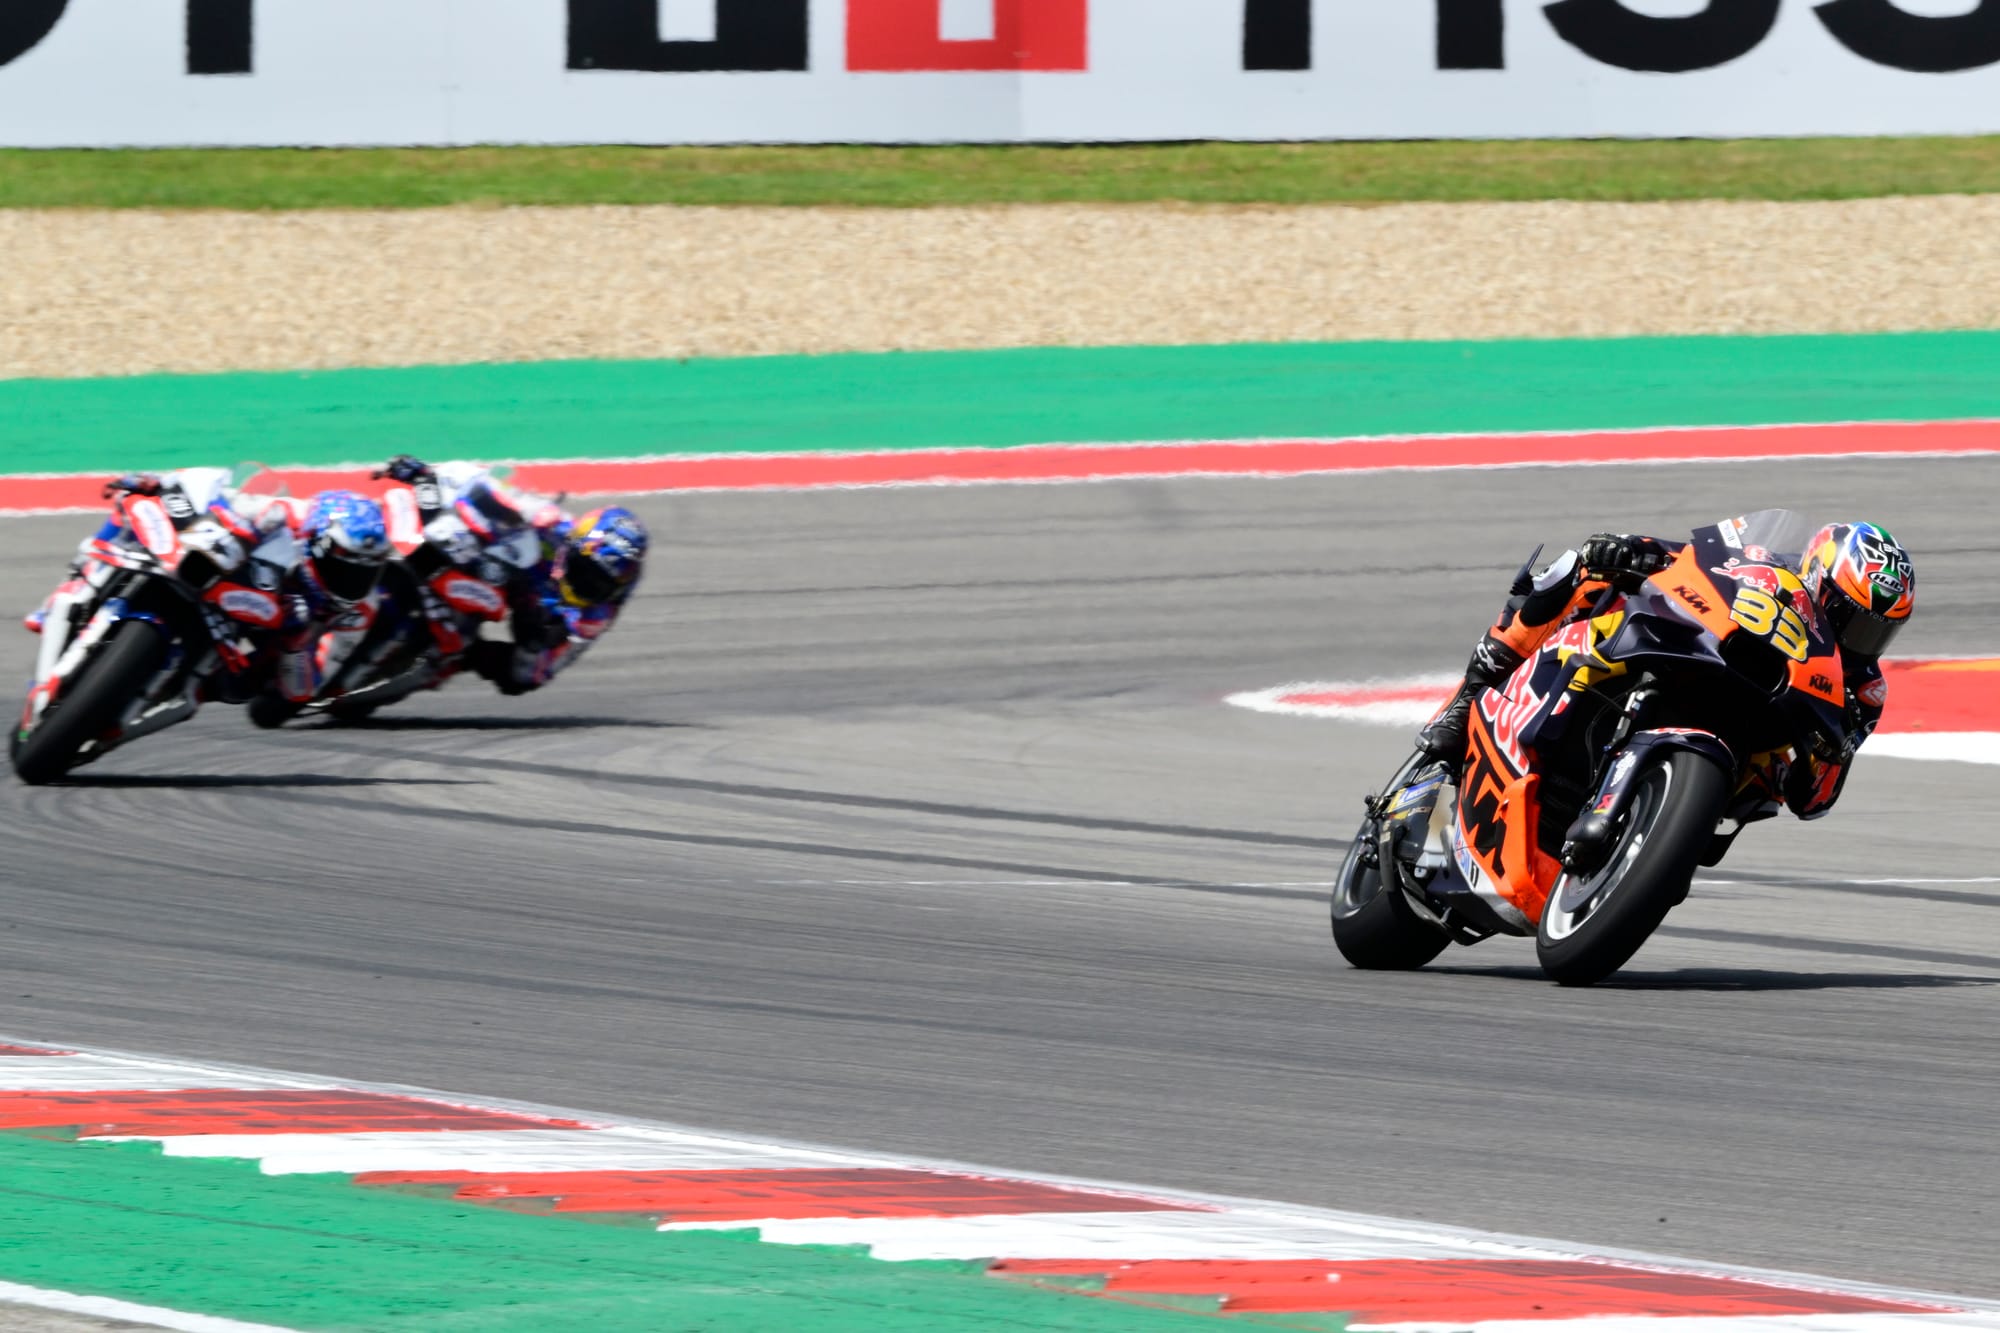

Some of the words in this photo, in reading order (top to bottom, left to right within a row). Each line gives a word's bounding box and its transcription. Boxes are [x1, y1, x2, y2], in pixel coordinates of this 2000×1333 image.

[1671, 585, 1712, 615] KTM
[1729, 587, 1809, 662] 33
[1809, 673, 1834, 696] KTM
[1459, 727, 1508, 880] TM
